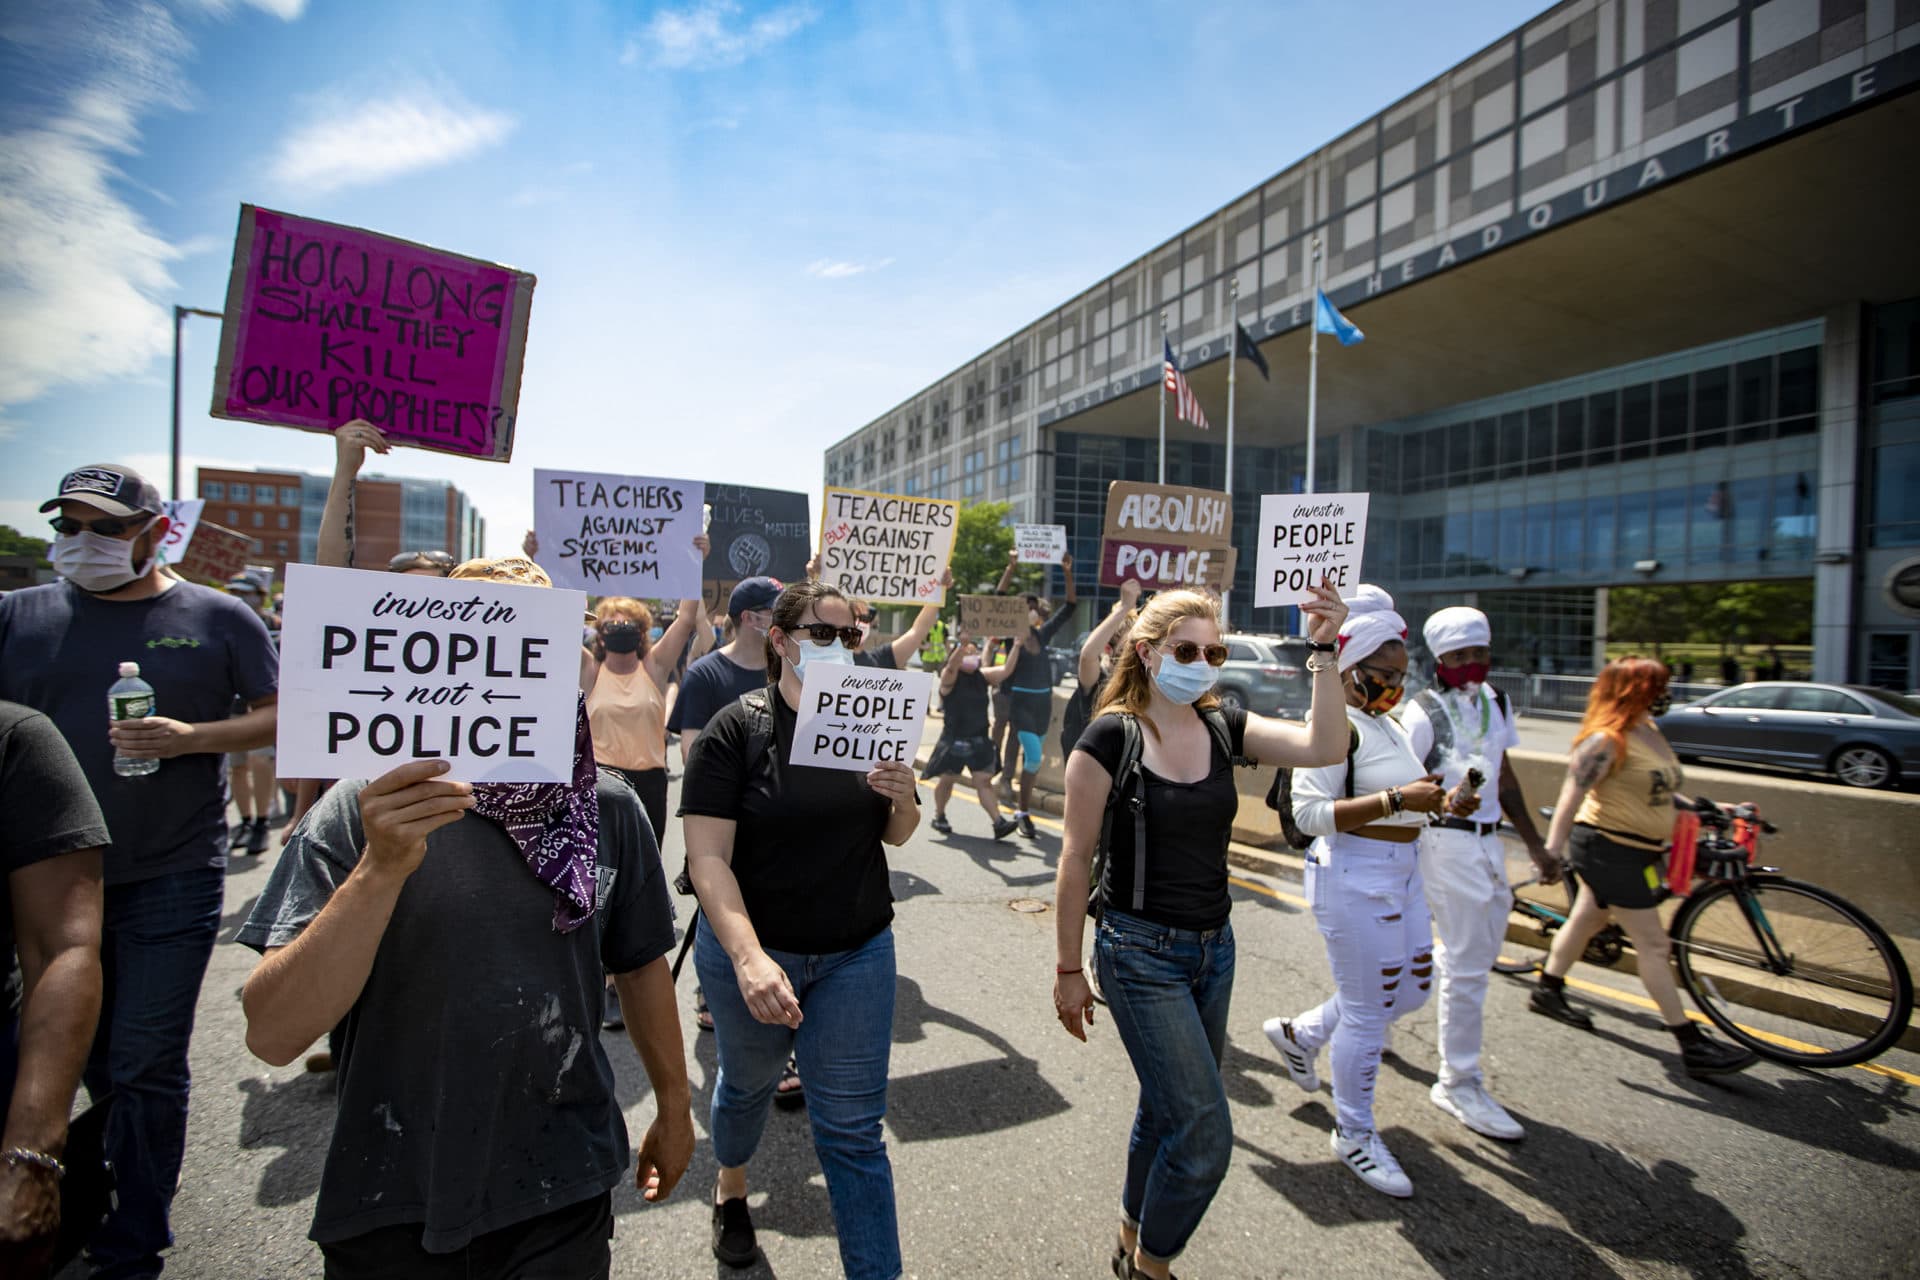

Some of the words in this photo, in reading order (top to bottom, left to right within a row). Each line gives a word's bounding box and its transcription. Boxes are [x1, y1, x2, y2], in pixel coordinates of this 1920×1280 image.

[260, 230, 369, 298] HOW
[380, 259, 505, 328] LONG
[256, 286, 380, 333] SHALL
[386, 314, 475, 358] THEY
[319, 331, 438, 386] KILL
[240, 364, 320, 409] OUR
[550, 478, 683, 512] TEACHERS
[714, 505, 765, 526] LIVES
[831, 493, 953, 528] TEACHERS
[1117, 493, 1226, 535] ABOLISH
[1292, 502, 1333, 519] invest
[1332, 503, 1346, 517] in
[579, 514, 675, 539] AGAINST
[823, 521, 852, 546] BLM
[846, 525, 935, 551] AGAINST
[1273, 522, 1356, 549] PEOPLE
[558, 537, 657, 558] SYSTEMIC
[825, 546, 937, 576] SYSTEMIC
[1305, 549, 1330, 563] not
[580, 558, 660, 583] RACISM
[1115, 544, 1211, 585] POLICE
[838, 572, 917, 598] RACISM
[917, 577, 940, 597] BLM
[372, 591, 484, 622] invest
[482, 599, 517, 625] in
[960, 598, 982, 613] NO
[321, 624, 550, 679] PEOPLE
[405, 682, 475, 707] not
[840, 674, 890, 692] invest
[888, 678, 904, 692] in
[816, 691, 917, 721] PEOPLE
[327, 711, 539, 759] POLICE
[851, 721, 883, 735] not
[813, 733, 909, 762] POLICE
